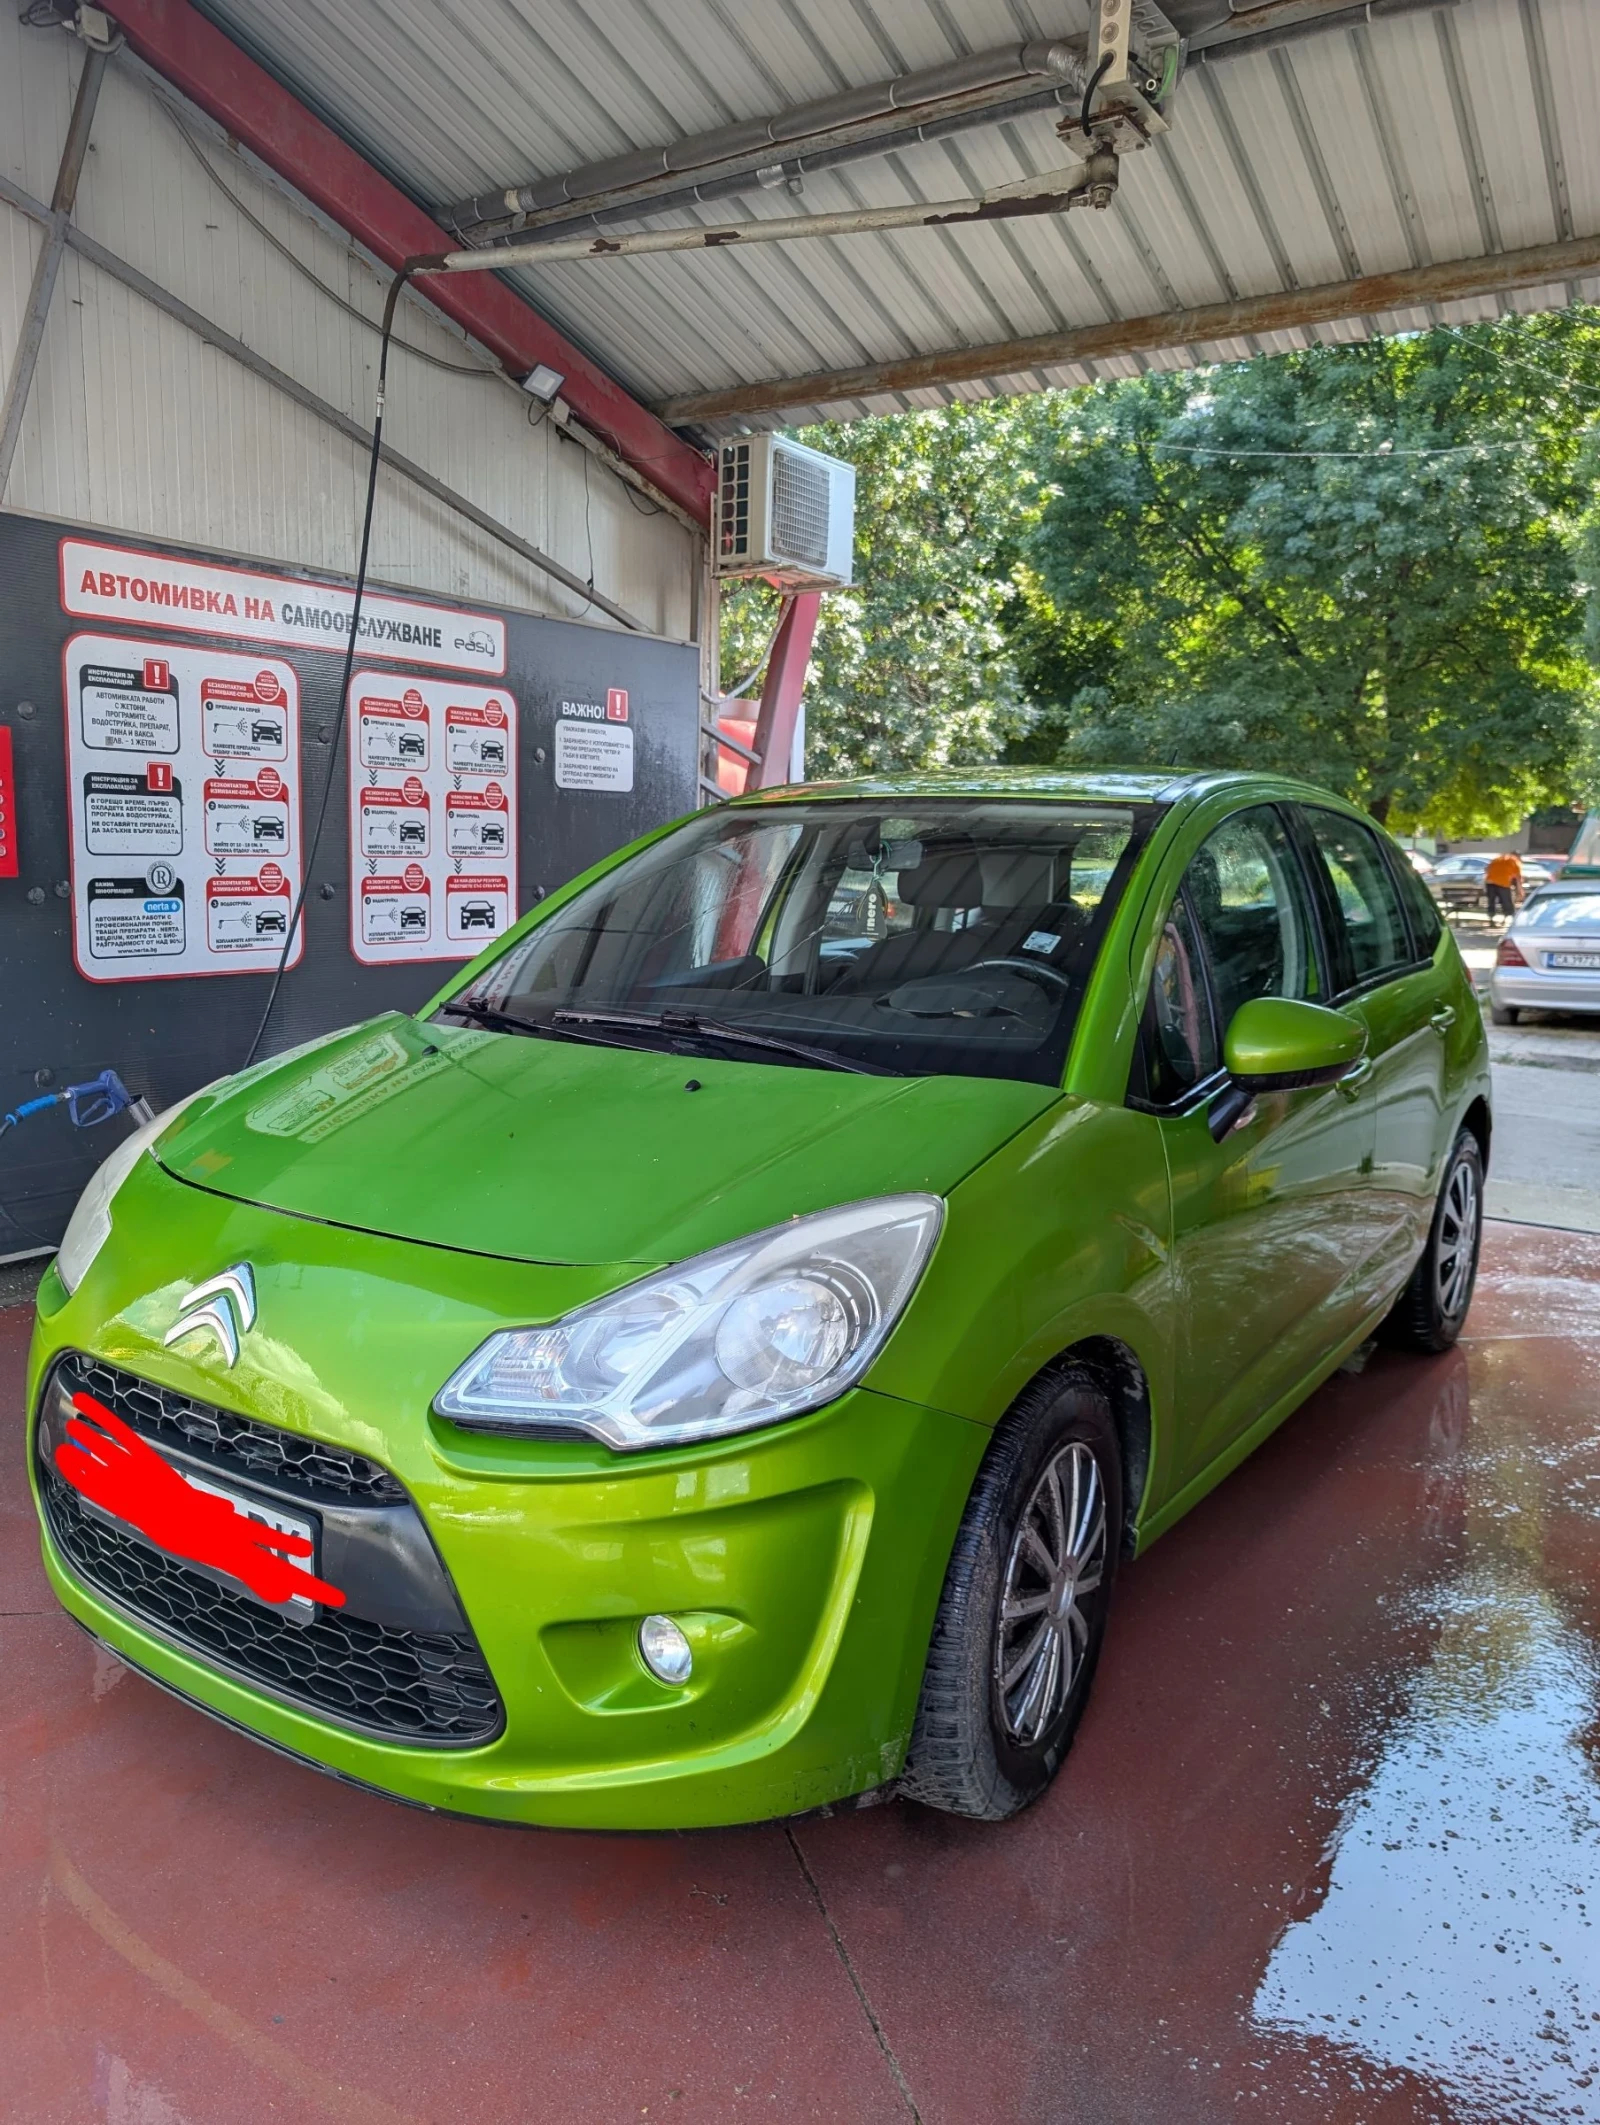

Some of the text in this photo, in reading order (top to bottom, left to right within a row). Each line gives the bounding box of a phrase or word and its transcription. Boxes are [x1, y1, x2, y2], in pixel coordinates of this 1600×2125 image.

[80, 570, 238, 616] АВТОМИВКА
[245, 597, 275, 622] НА
[454, 634, 496, 657] easy
[88, 669, 126, 678] ИНСТРУКЦИЯ
[88, 676, 132, 686] ЕКСПЛОАТАЦИЯ
[96, 692, 140, 702] АВТОМИВКАТА
[106, 710, 145, 719] ПРОГРАМИТЕ
[563, 702, 604, 719] ВАЖНО!
[92, 718, 170, 731] ВОДОСТРУЙКА, ПРЕПАРАТ,
